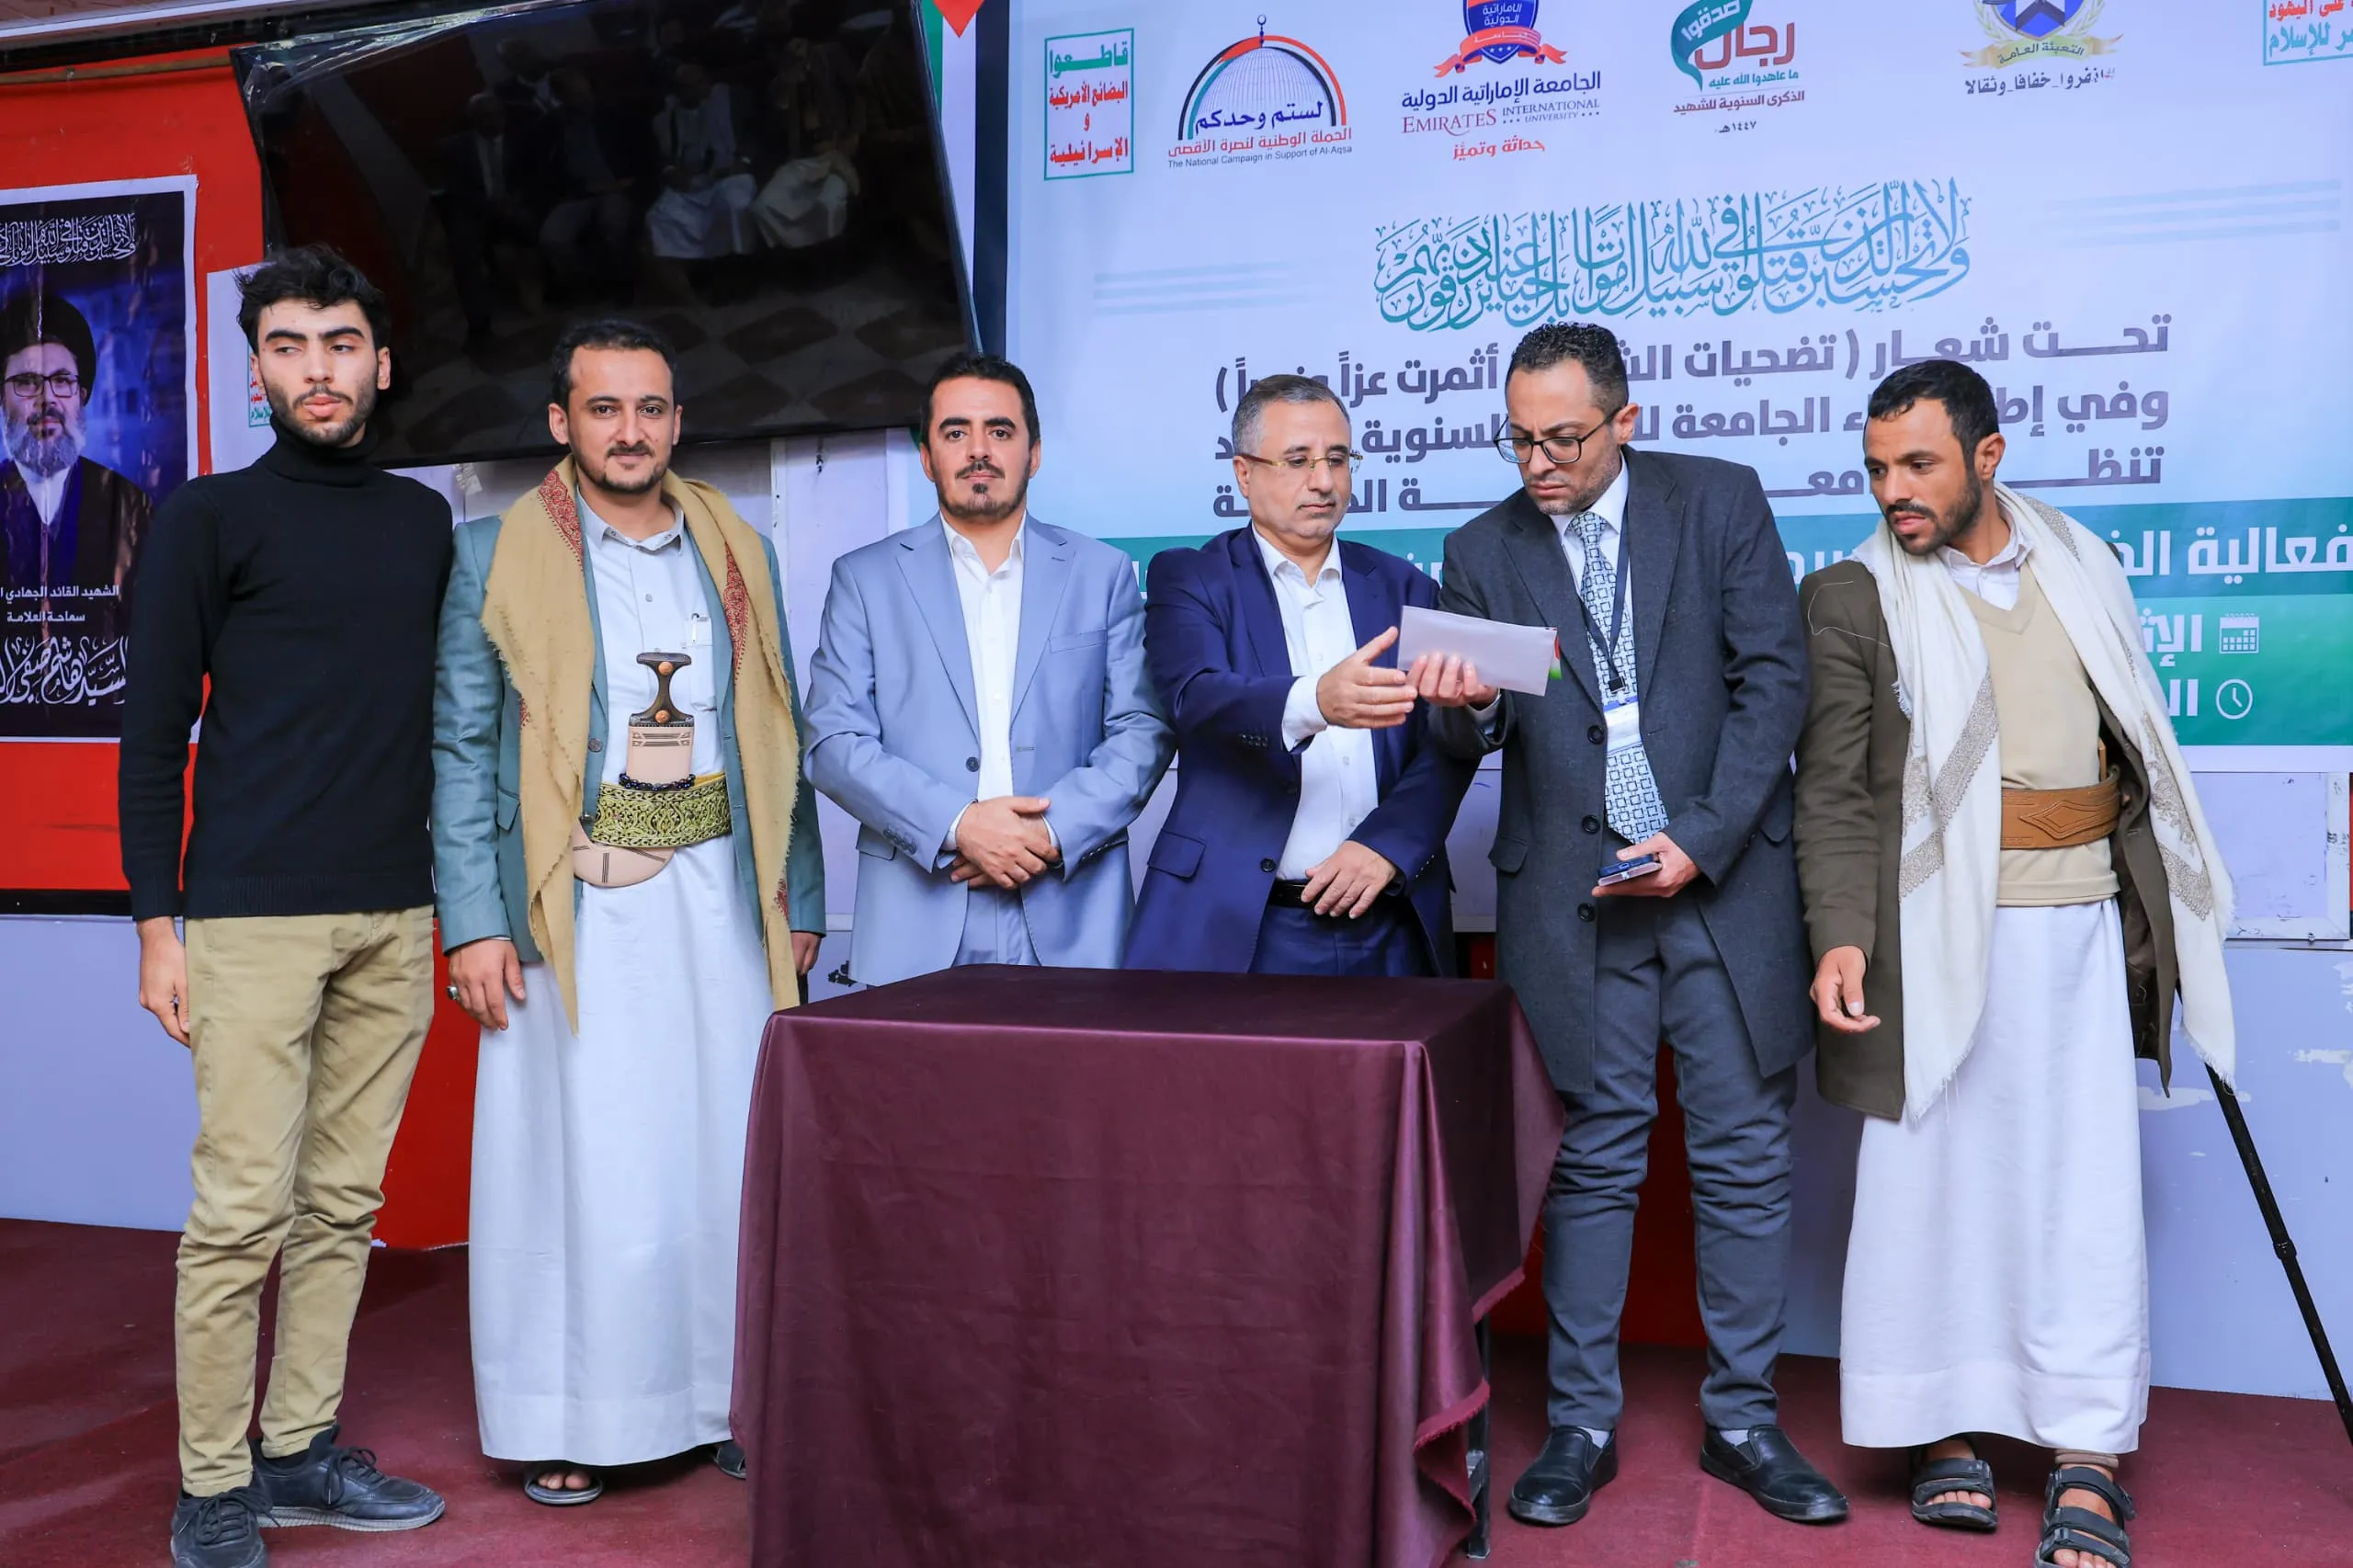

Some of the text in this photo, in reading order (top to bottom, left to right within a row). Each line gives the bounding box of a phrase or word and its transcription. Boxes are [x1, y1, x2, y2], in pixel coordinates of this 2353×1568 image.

[1680, 0, 1742, 41] صدقوا
[1694, 22, 1795, 71] رجال
[1997, 41, 2085, 64] التعبئة العامة
[1049, 40, 1129, 79] قاطعوا
[1401, 71, 1601, 111] الجامعة الإماراتية الدولية
[1708, 69, 1800, 90] ما عاهدوا الله عليه
[1502, 98, 1601, 118] INTERNATIONAL
[1673, 90, 1806, 116] الذكرى السنوية للشهيد
[1083, 112, 1091, 132] و
[1195, 101, 1324, 136] لستم وحدكم
[1401, 108, 1497, 137] EMIRATES
[1524, 111, 1579, 124] UNIVERSITY
[1220, 136, 1255, 154] لنصرة
[1258, 131, 1307, 151] الوطنية
[1311, 127, 1352, 144] الحملة
[1502, 135, 1546, 153] حداثة
[1168, 144, 1353, 169] The National Campaign in Support of Al-Aqsa
[1869, 316, 2009, 381] شعار
[1396, 342, 1499, 405] أثمرت
[2057, 381, 2169, 433] وفي
[1671, 396, 1831, 447] الجامعة
[5, 585, 49, 605] الجهادي
[50, 585, 79, 598] القائد
[80, 584, 120, 600] الشهيد
[6, 610, 86, 623] سماحة العلامة
